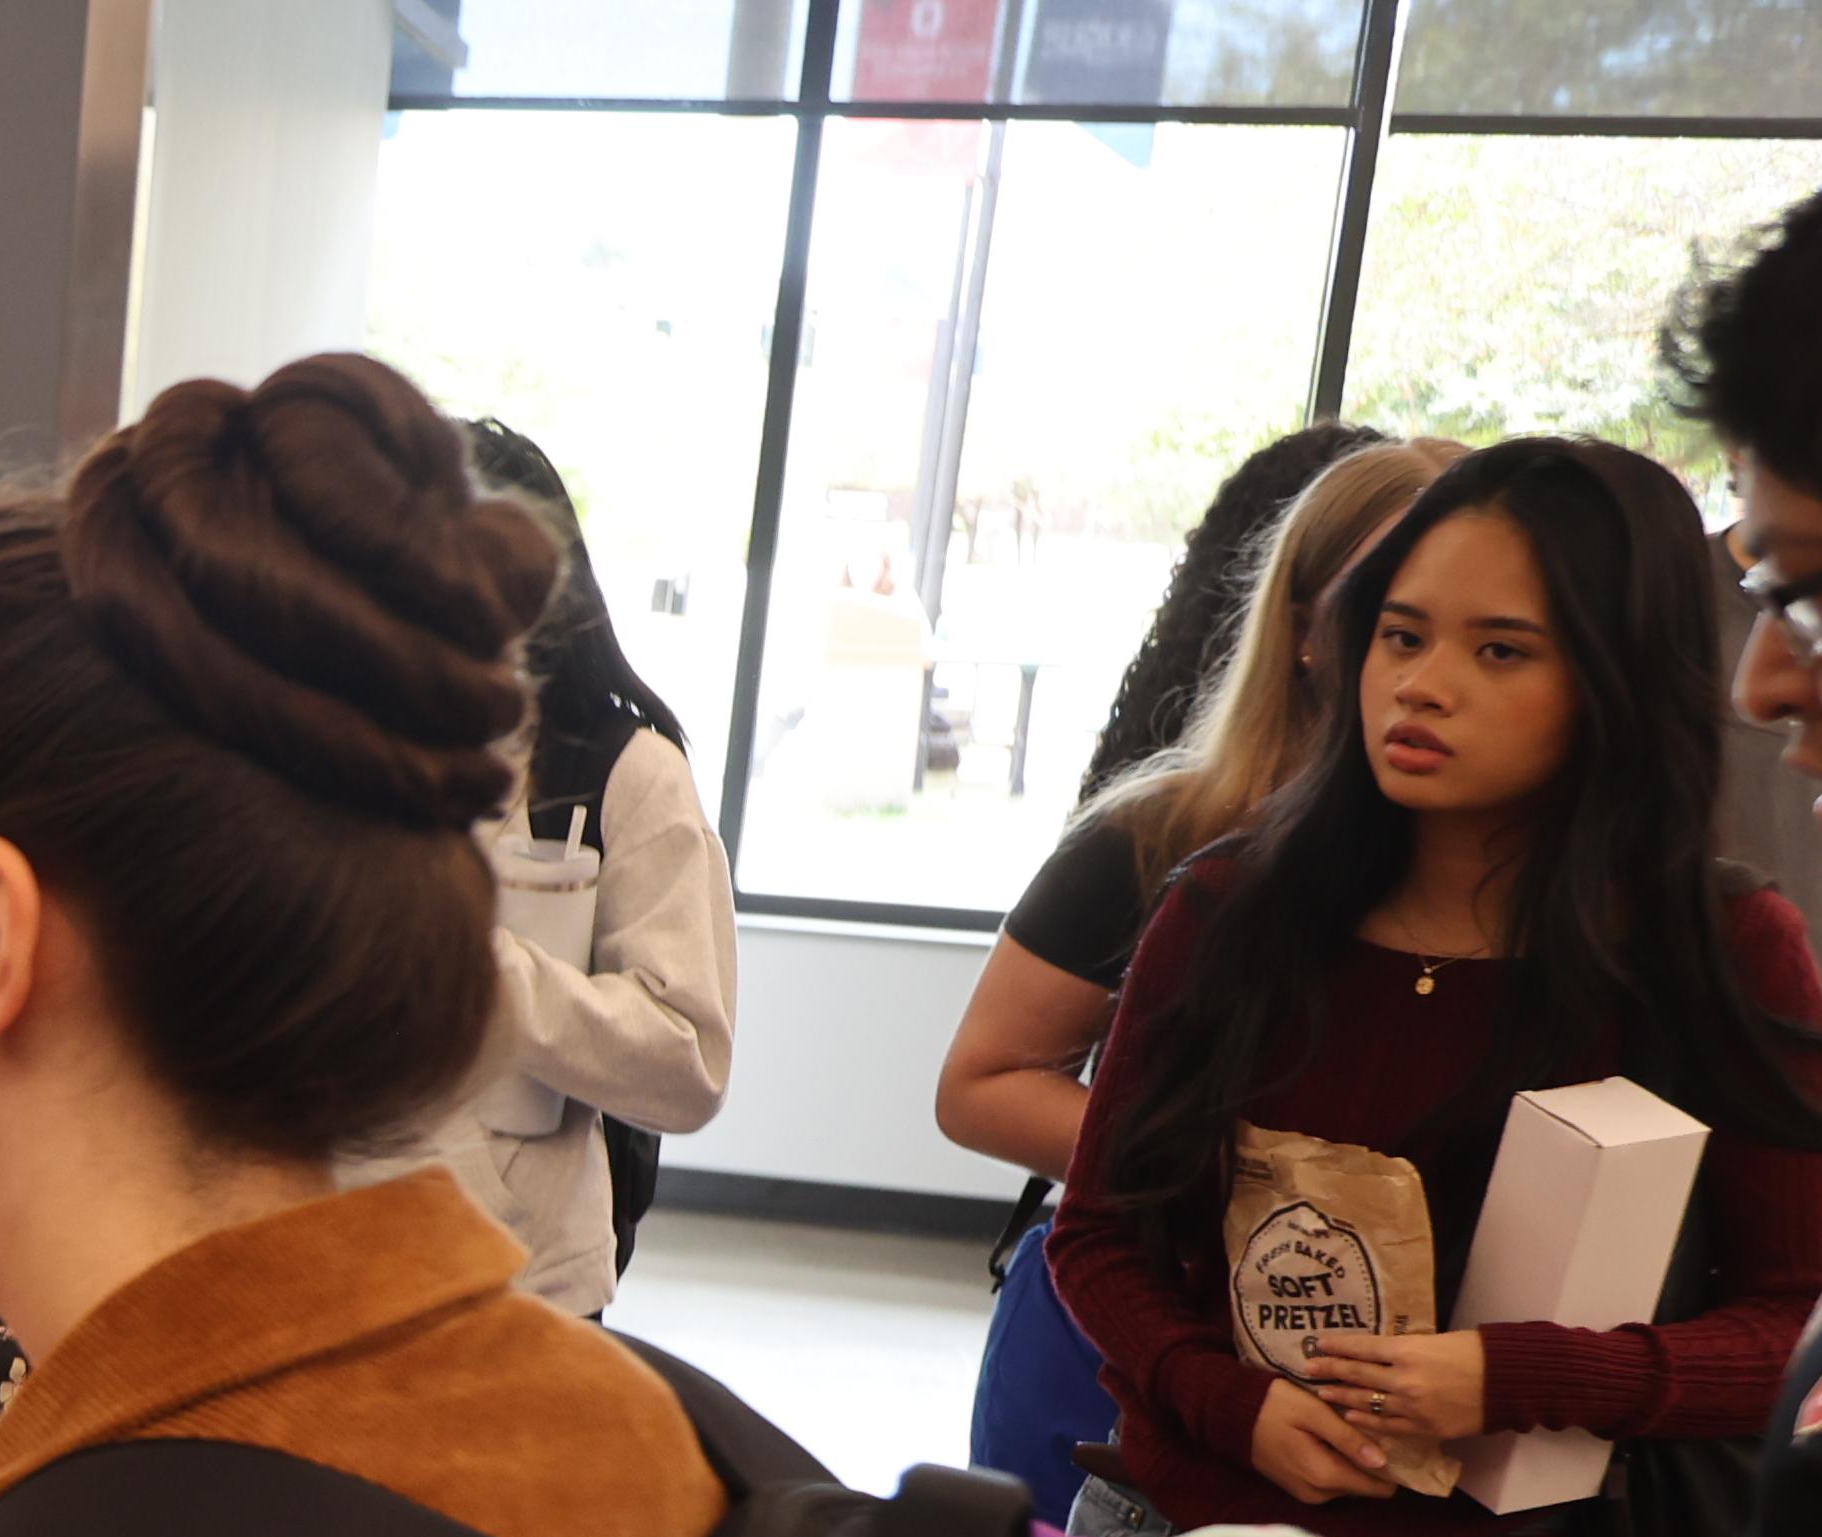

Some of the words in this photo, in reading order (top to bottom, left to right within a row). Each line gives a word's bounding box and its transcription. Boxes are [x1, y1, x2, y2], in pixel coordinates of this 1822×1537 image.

[1294, 1241, 1346, 1279] BAKED
[1268, 1272, 1334, 1298] SOFT
[1258, 1304, 1368, 1331] PRETZEL
